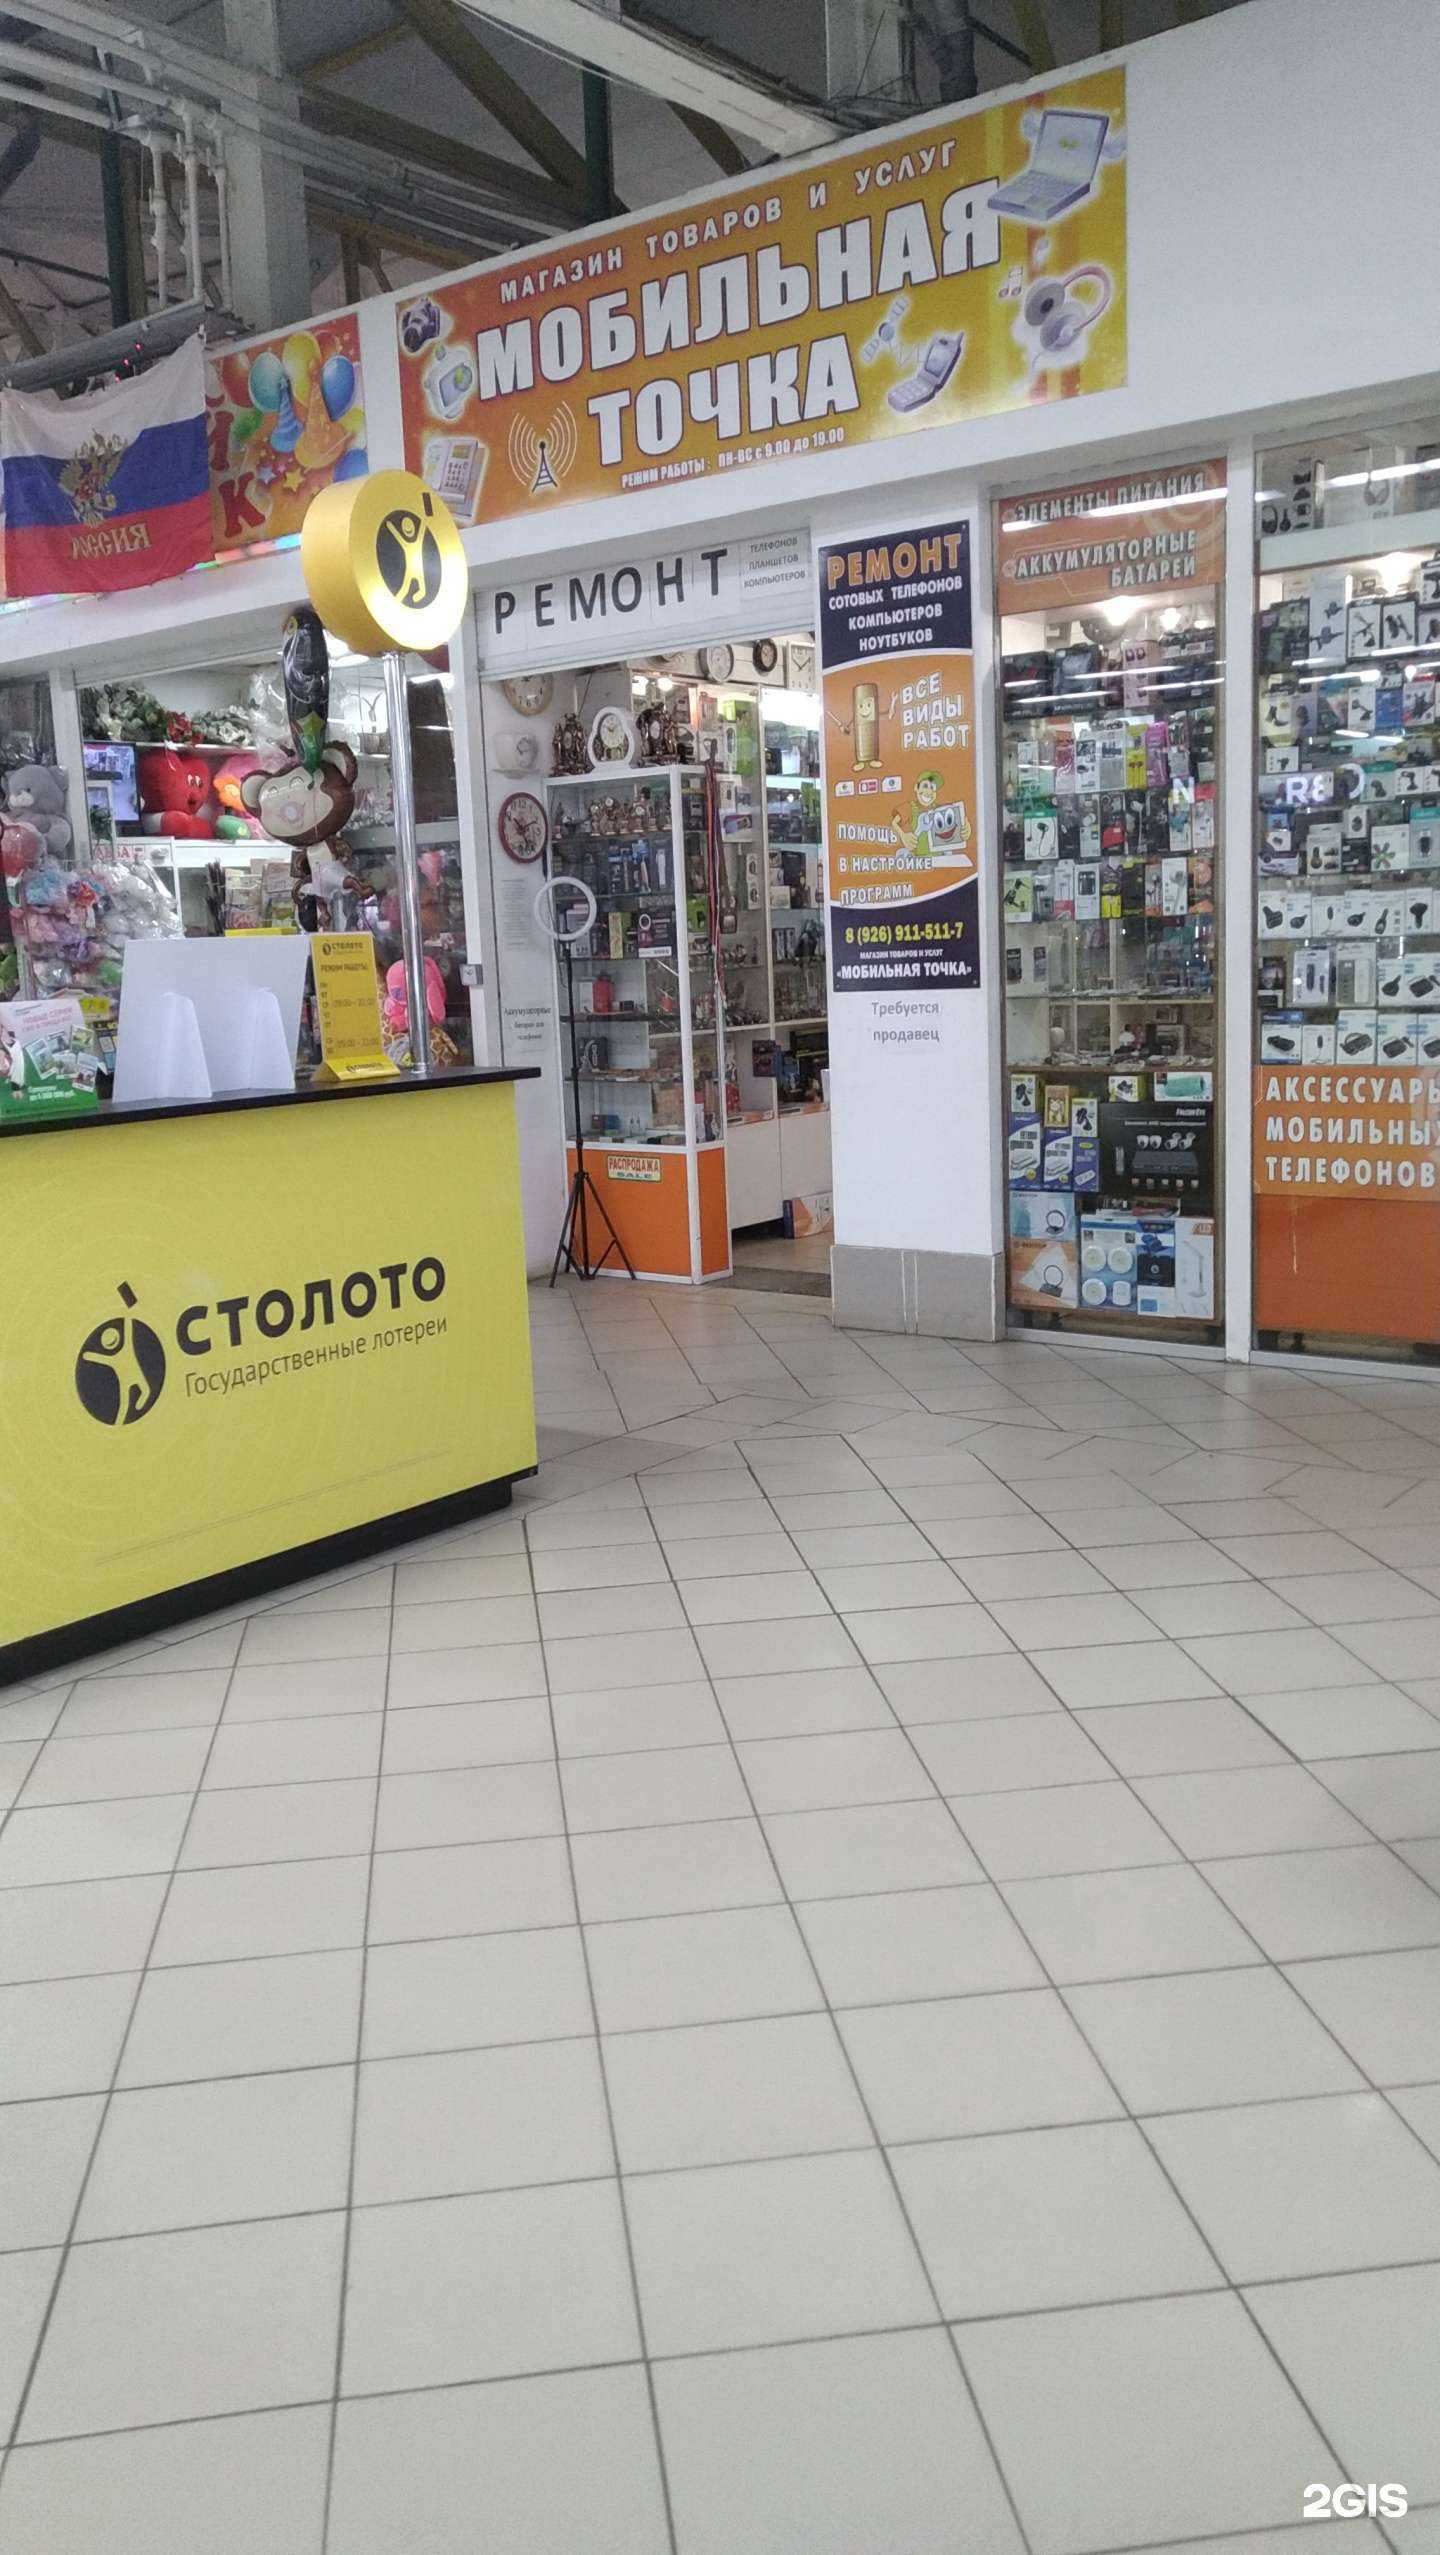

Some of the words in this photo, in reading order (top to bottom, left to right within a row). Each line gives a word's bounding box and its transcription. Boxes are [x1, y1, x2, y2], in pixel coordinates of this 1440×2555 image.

[500, 248, 623, 302] МАГАЗИН
[647, 197, 781, 253] ТОВАРОВ
[809, 183, 826, 210] И
[855, 140, 955, 196] УСЛУГ
[477, 179, 999, 401] МОБИЛЬНАЯ
[587, 335, 859, 484] ТОЧКА
[622, 469, 658, 488] РЕЖИМ
[718, 449, 753, 467] ПН-ВС
[793, 436, 809, 453] до
[1016, 488, 1109, 522] ЭЛЕМЕНТЫ
[1117, 473, 1206, 505] ПИТАНИЯ
[72, 523, 152, 560] РОССИЯ
[750, 536, 797, 553] ТЕЛЕФОНОВ
[1015, 530, 1196, 579] АККУМУЛЯТОРНЫЕ
[749, 554, 798, 570] ПЛАНШЕТОВ
[827, 533, 962, 590] РЕМОНТ
[495, 549, 727, 634] РЕМОНТ
[744, 570, 805, 588] КОМПЬЮТЕРОВ
[829, 589, 884, 610] СОТОВЫХ
[891, 575, 962, 600] ТЕЛЕФОНОВ
[849, 603, 943, 631] КОМПЬЮТЕРОВ
[859, 627, 933, 651] НОУТБУКОВ
[902, 672, 941, 704] ВСЕ
[902, 694, 963, 727] ВИДЫ
[903, 724, 969, 750] РАБОТ
[837, 824, 897, 844] ПОМОЩЬ
[839, 855, 848, 873] В
[851, 854, 933, 872] НАСТРОЙКЕ
[840, 883, 914, 905] ПРОГРАММ
[845, 926, 854, 944] 8
[857, 925, 892, 946] (926)
[896, 922, 963, 943] 911-511-7
[860, 951, 889, 960] МАГАЗИН
[890, 950, 918, 959] ТОВАРОВ
[925, 949, 943, 957] УСЛУГ
[837, 964, 921, 981] «МОБИЛЬНАЯ
[923, 960, 972, 977] ТОЧКА»
[871, 1001, 939, 1017] Требуется
[873, 1028, 940, 1044] продавец
[609, 1157, 659, 1172] РАСПРОДАЖА
[1266, 1156, 1436, 1188] ТЕЛЕФОНОВ
[176, 1256, 446, 1356] СТОЛОТО
[185, 1333, 366, 1397] Государственные
[372, 1316, 447, 1351] лотереи
